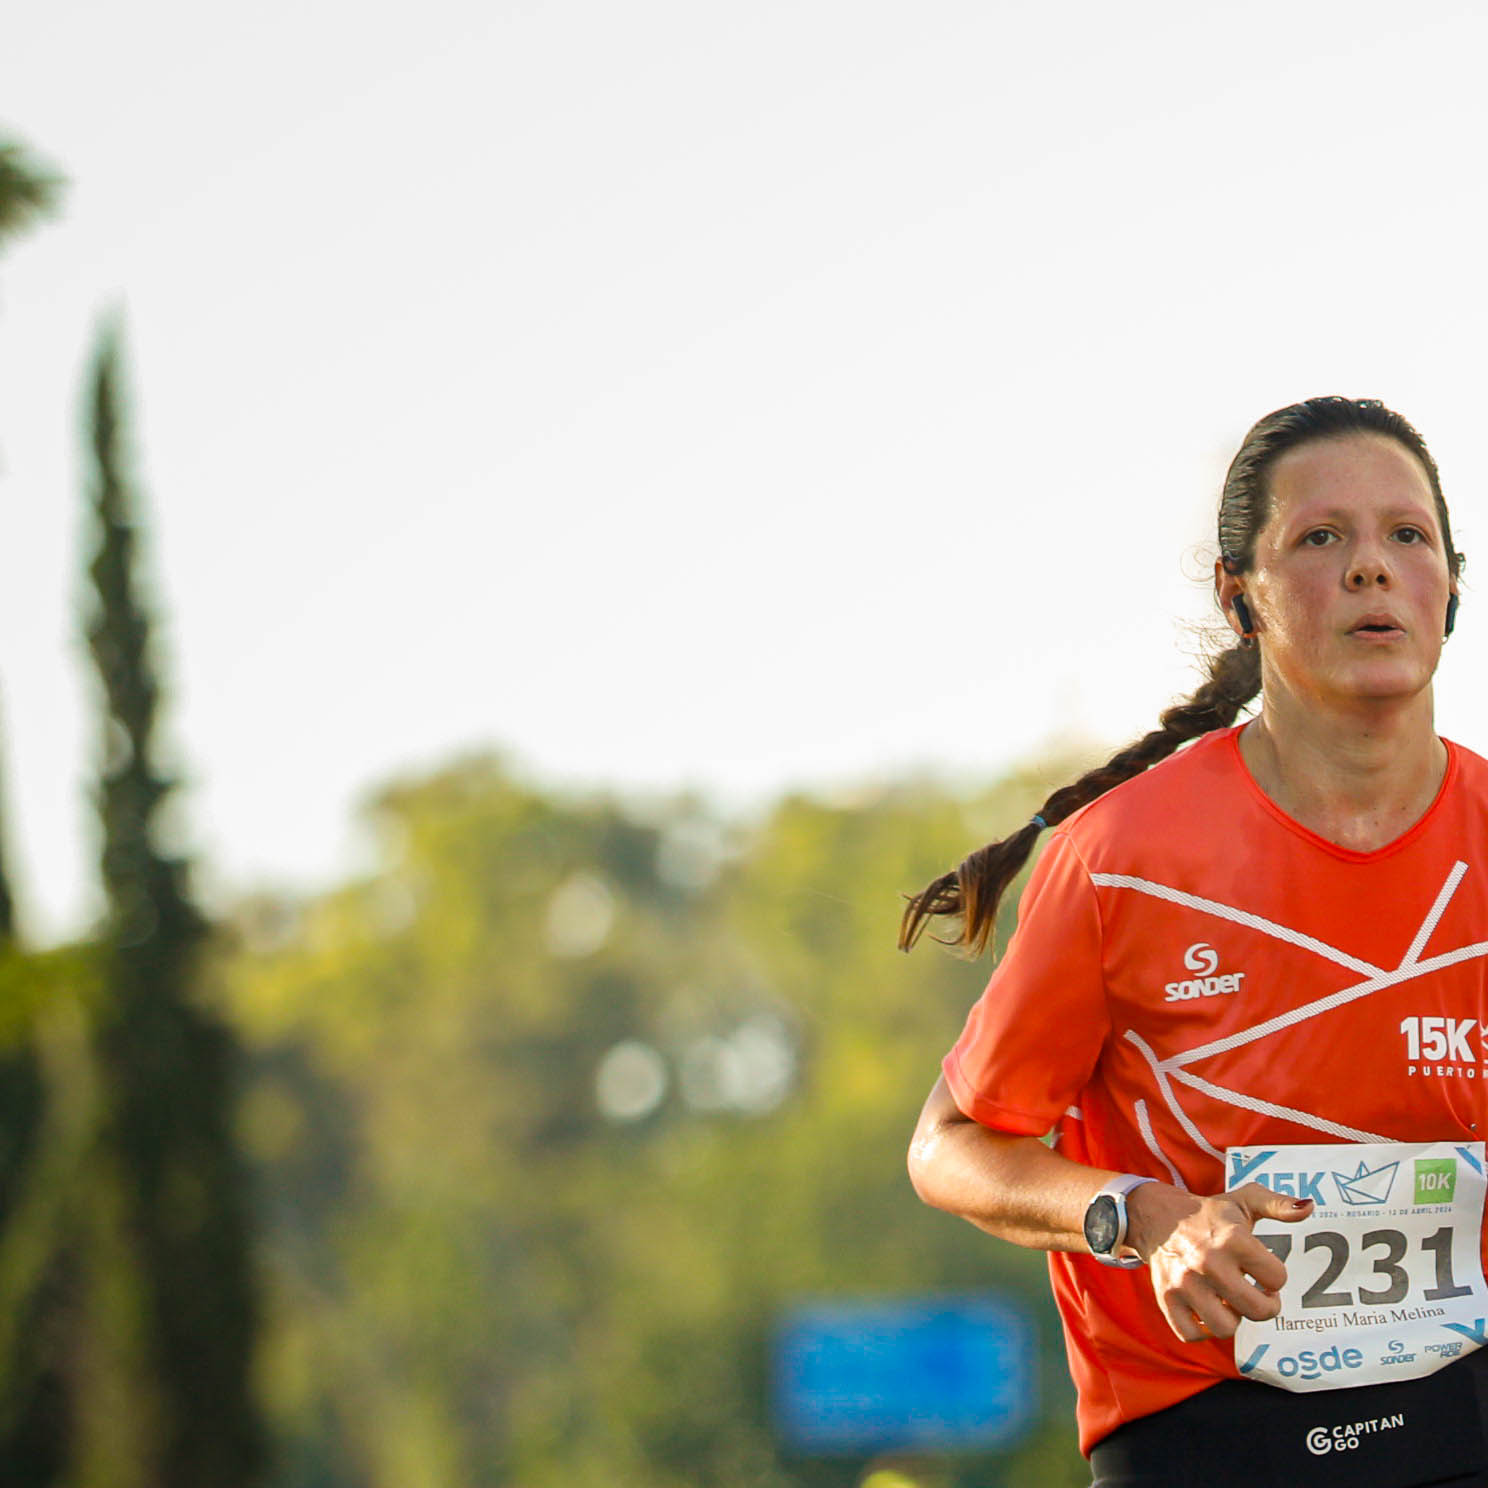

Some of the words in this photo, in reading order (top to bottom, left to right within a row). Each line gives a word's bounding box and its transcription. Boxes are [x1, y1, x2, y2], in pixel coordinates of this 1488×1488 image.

[1400, 1016, 1478, 1062] 15K
[1407, 1065, 1476, 1079] PUERTO
[1418, 1172, 1452, 1191] 10K
[1343, 1312, 1388, 1327] Maria
[1390, 1306, 1446, 1322] Melina
[1277, 1345, 1364, 1380] osde
[1332, 1413, 1404, 1438] CAPITAN
[1334, 1437, 1360, 1451] GO
